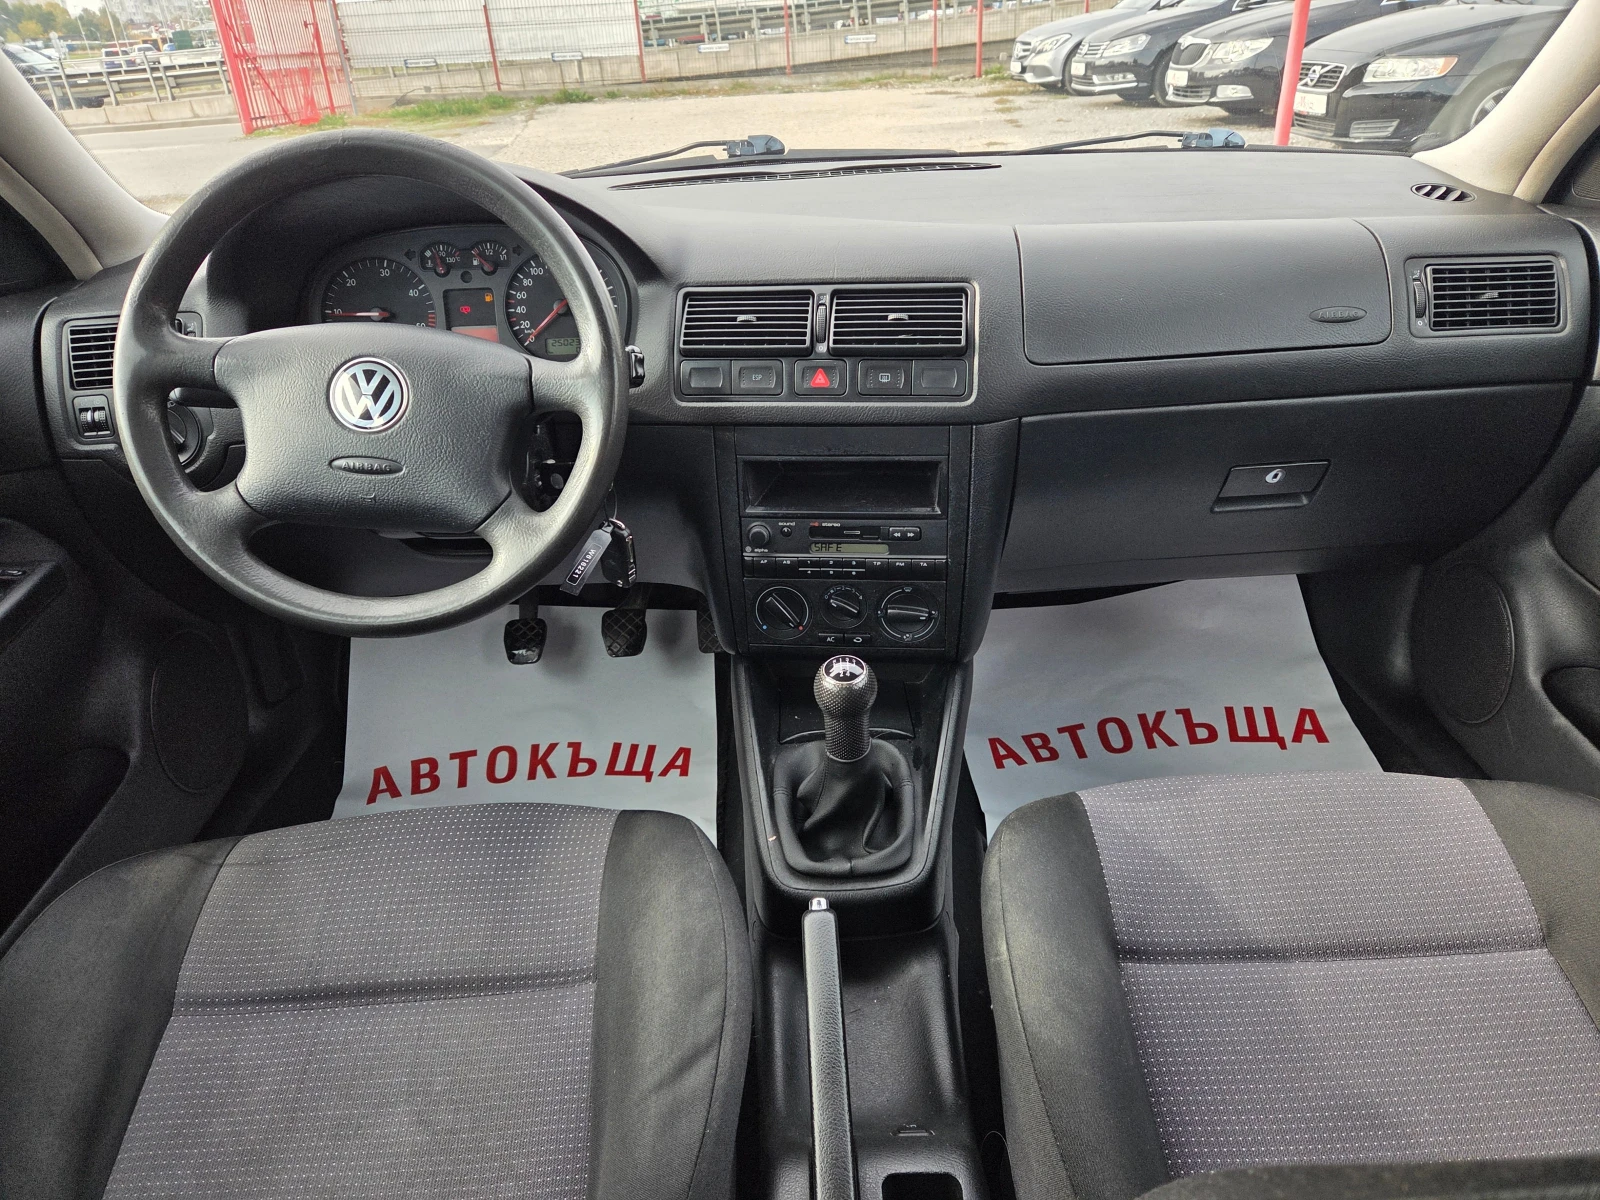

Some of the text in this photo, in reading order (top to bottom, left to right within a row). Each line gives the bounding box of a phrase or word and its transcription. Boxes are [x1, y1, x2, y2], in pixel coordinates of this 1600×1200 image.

[1318, 310, 1359, 319] AIRBAG
[342, 461, 392, 472] AIRBAG
[814, 543, 843, 552] SAFE
[987, 706, 1330, 770] АВТОКЪЩА
[366, 741, 692, 806] АВТОКЪЩА
